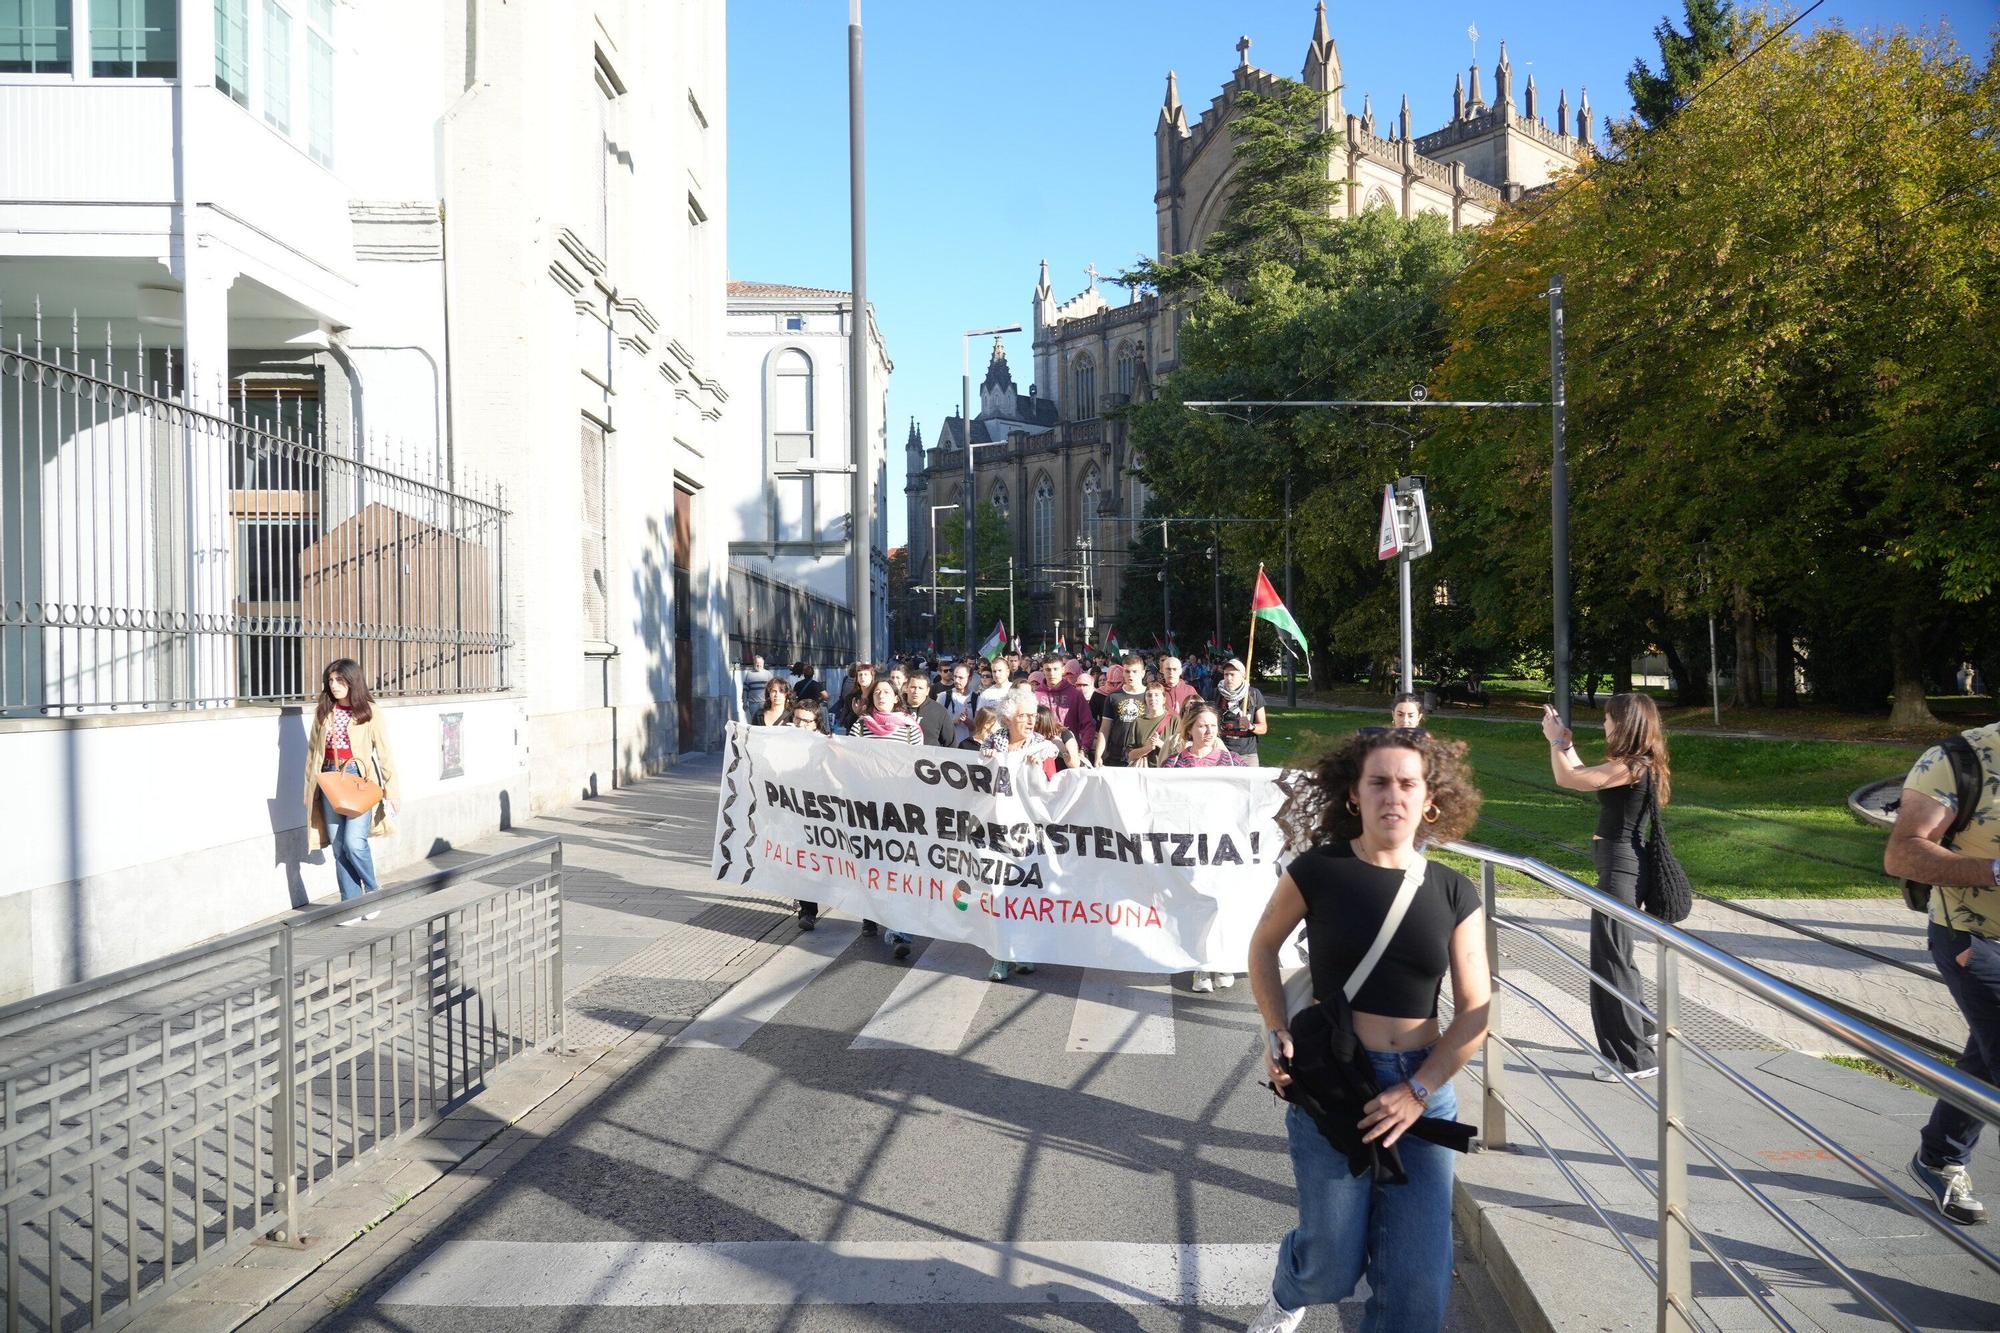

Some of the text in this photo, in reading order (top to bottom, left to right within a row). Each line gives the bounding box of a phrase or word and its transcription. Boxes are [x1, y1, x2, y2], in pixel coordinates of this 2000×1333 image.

[914, 758, 1013, 797] GORA
[764, 780, 929, 836] PALESTINAR
[979, 892, 1163, 929] ELKARTASUNA
